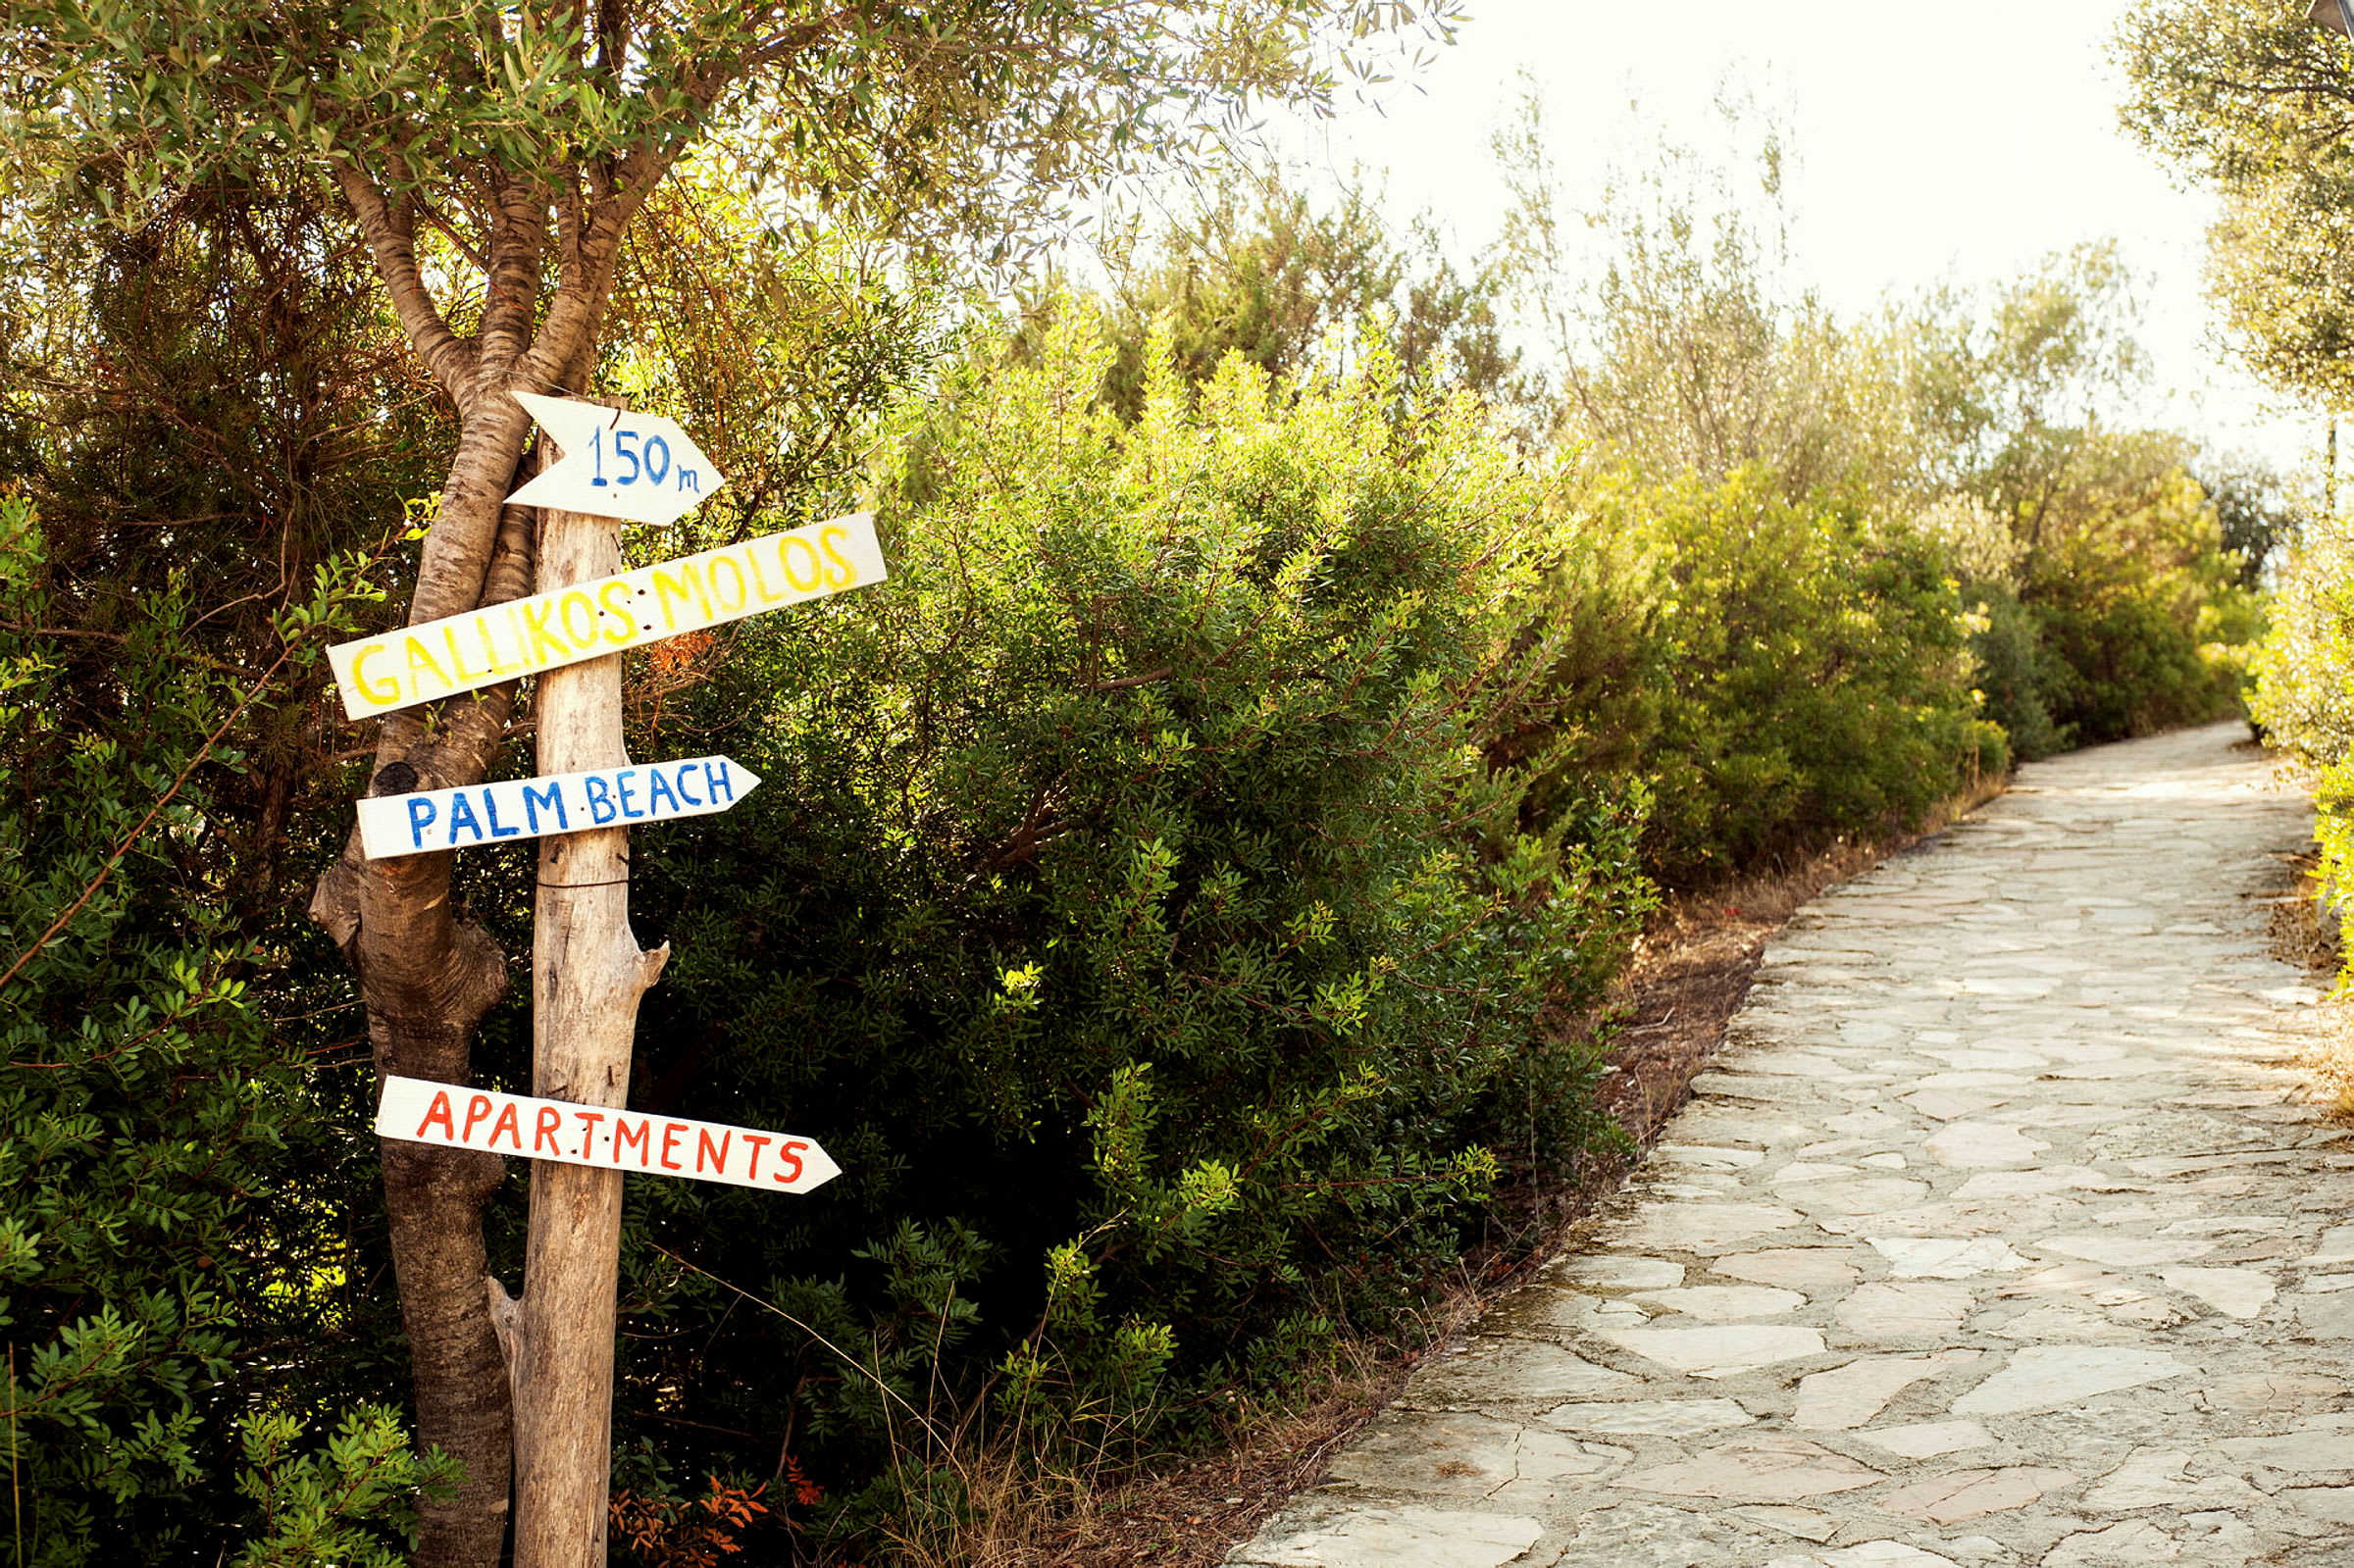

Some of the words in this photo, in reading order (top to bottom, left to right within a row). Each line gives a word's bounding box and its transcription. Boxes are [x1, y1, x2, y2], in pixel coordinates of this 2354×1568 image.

[351, 581, 638, 705] GALLIKOS
[651, 526, 858, 630] MOLOS
[407, 782, 568, 848] PALM
[584, 762, 733, 825] BEACH
[416, 1090, 808, 1183] APARTMENTS
